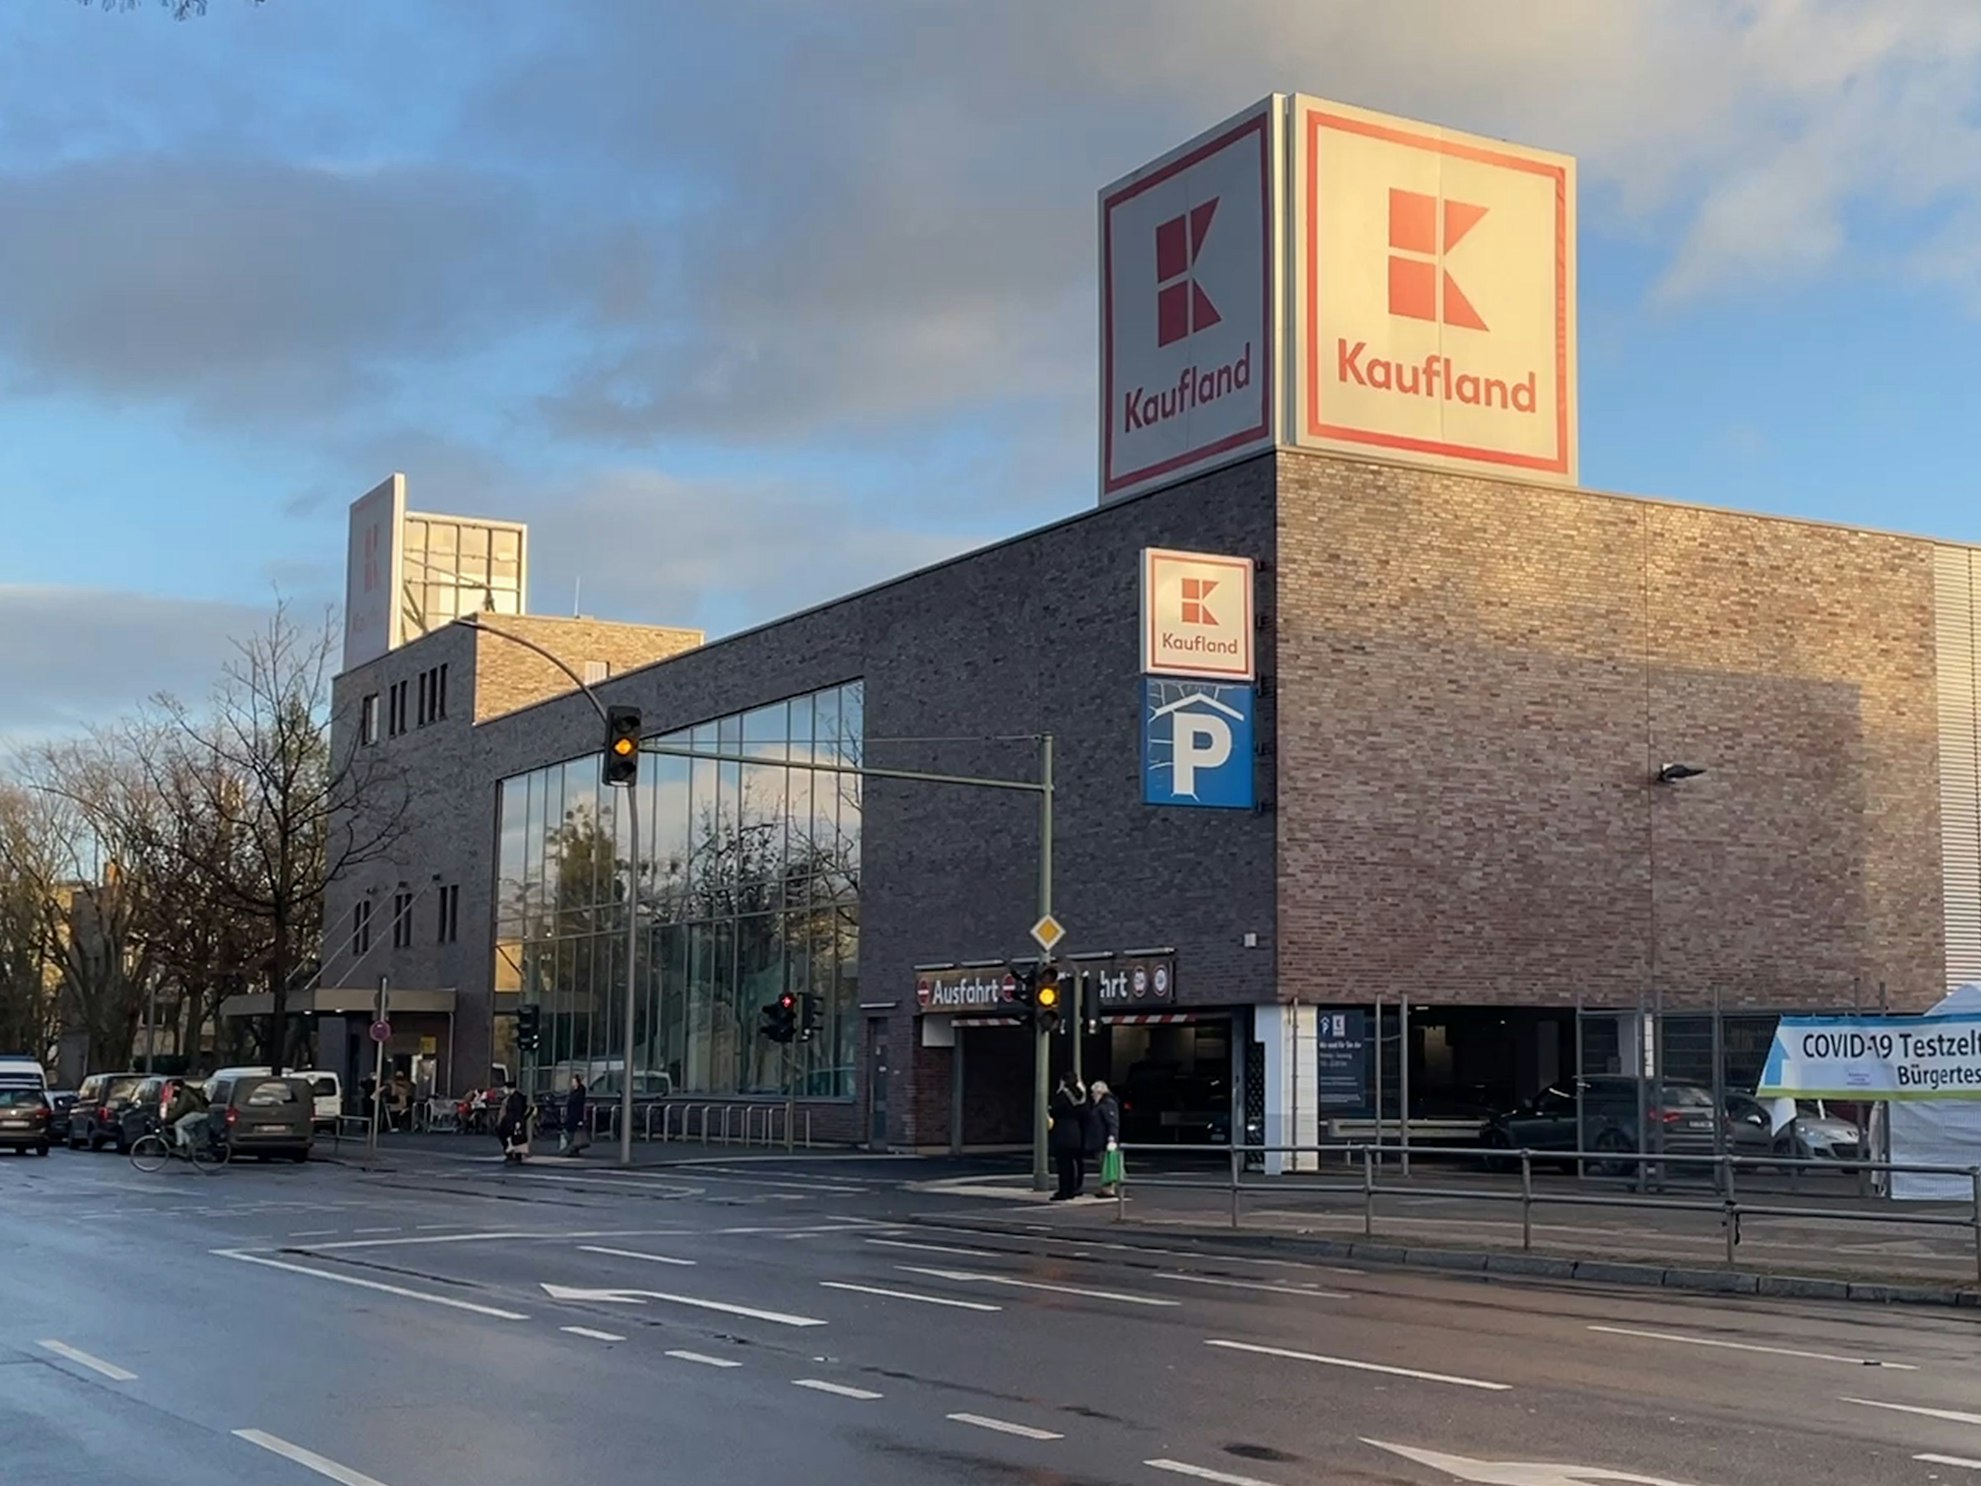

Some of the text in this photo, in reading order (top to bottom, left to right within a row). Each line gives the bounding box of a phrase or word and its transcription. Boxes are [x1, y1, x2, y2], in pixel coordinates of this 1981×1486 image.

[1124, 342, 1250, 433] Kaufland
[1337, 338, 1536, 413] Kaufland
[1163, 633, 1238, 654] Kaufland
[1173, 711, 1233, 795] P
[932, 978, 999, 1005] Ausfahrt
[1803, 1033, 1893, 1059] COVID-19
[1898, 1064, 1981, 1089] Bürgertes
